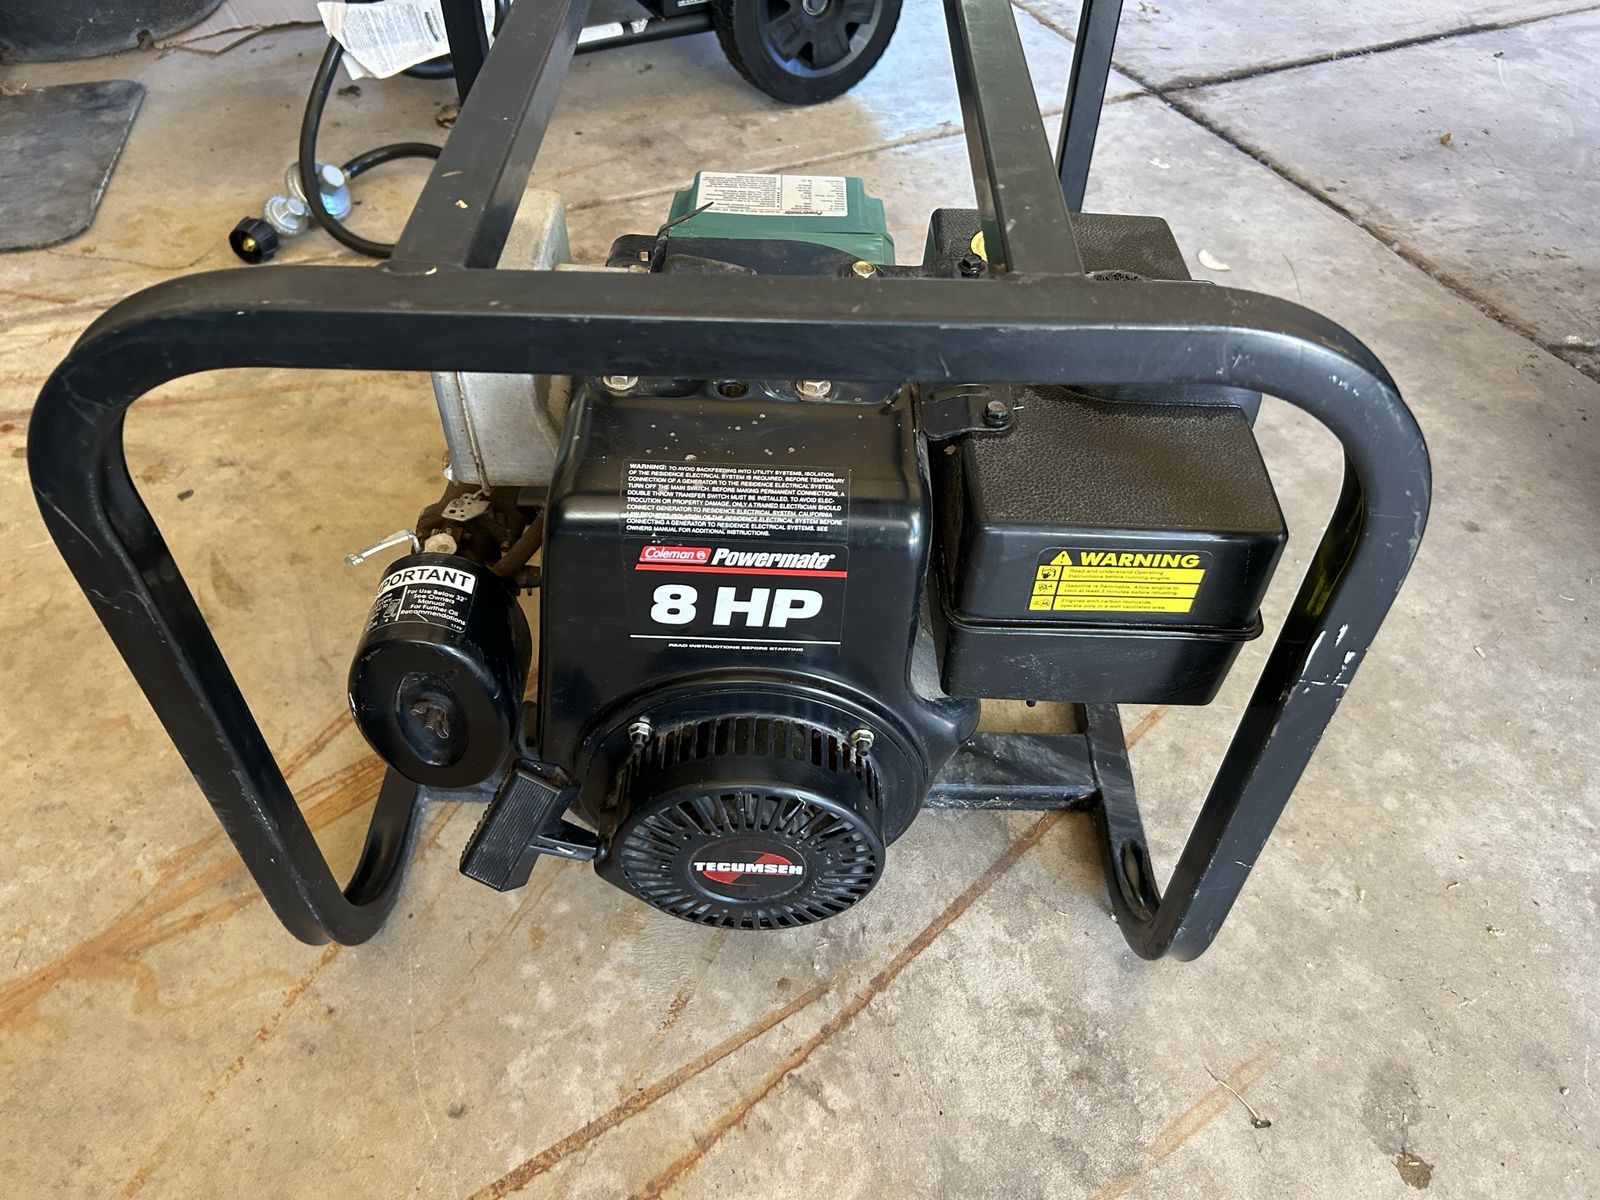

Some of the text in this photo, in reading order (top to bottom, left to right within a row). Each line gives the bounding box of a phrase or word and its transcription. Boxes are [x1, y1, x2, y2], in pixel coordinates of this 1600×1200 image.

[629, 463, 667, 471] WARNING:
[736, 508, 771, 516] ELECTRICAL
[645, 547, 694, 560] Coleman
[1080, 552, 1200, 568] WARNING
[378, 569, 471, 593] PORTANT
[428, 594, 455, 604] Owners
[433, 590, 455, 598] Below
[418, 599, 445, 607] Manual
[650, 584, 823, 628] 8 HP
[422, 604, 447, 613] Further
[448, 609, 459, 617] Oil
[400, 609, 466, 626] Recommendations
[694, 862, 803, 875] TECUMSEH
